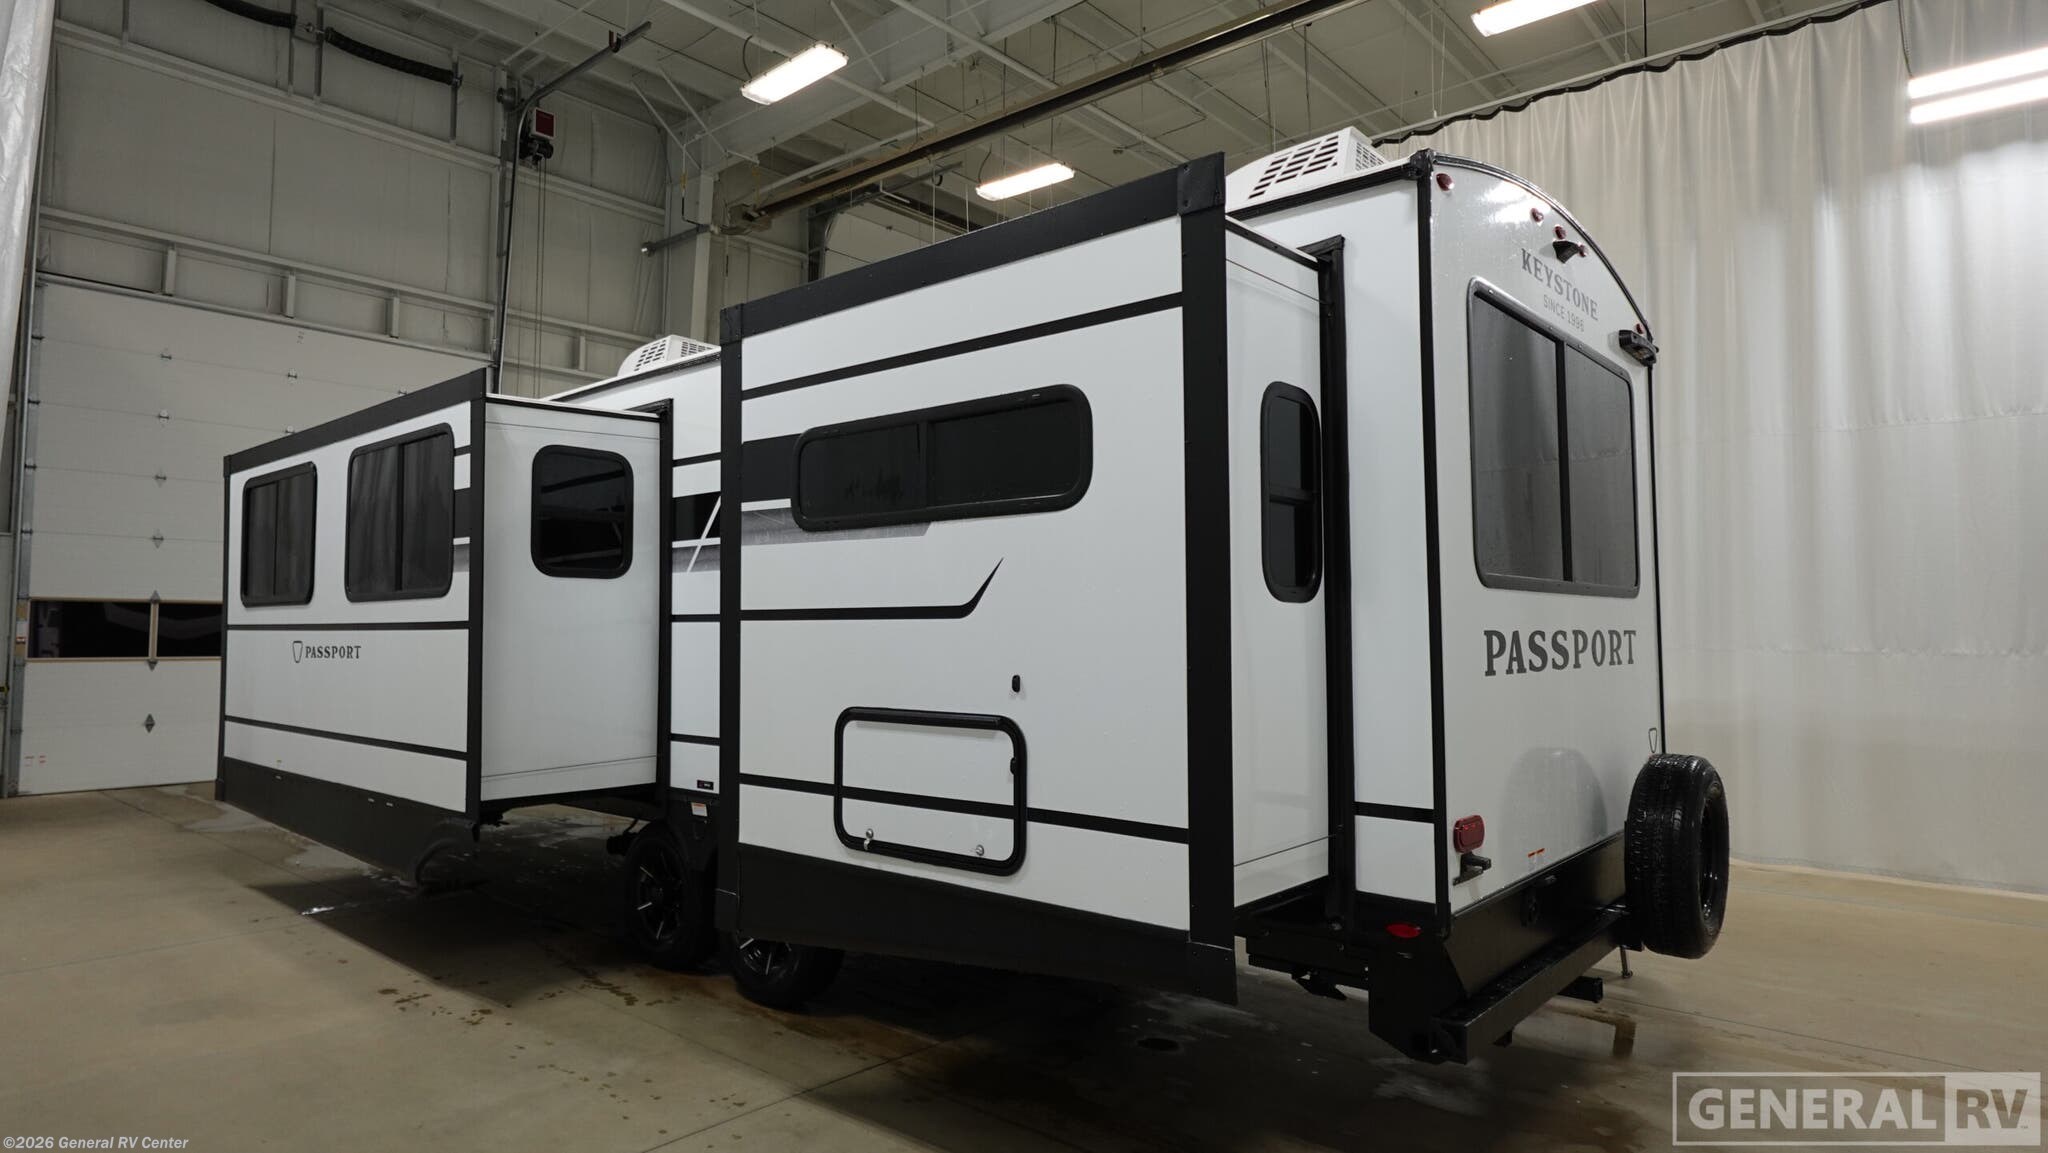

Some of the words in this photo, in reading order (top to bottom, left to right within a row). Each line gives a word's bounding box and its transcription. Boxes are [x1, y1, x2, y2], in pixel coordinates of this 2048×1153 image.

[1521, 247, 1598, 321] KEYSTONE
[1543, 294, 1565, 319] SINCE
[305, 645, 362, 659] PASSPORT
[1483, 629, 1637, 677] PASSPORT
